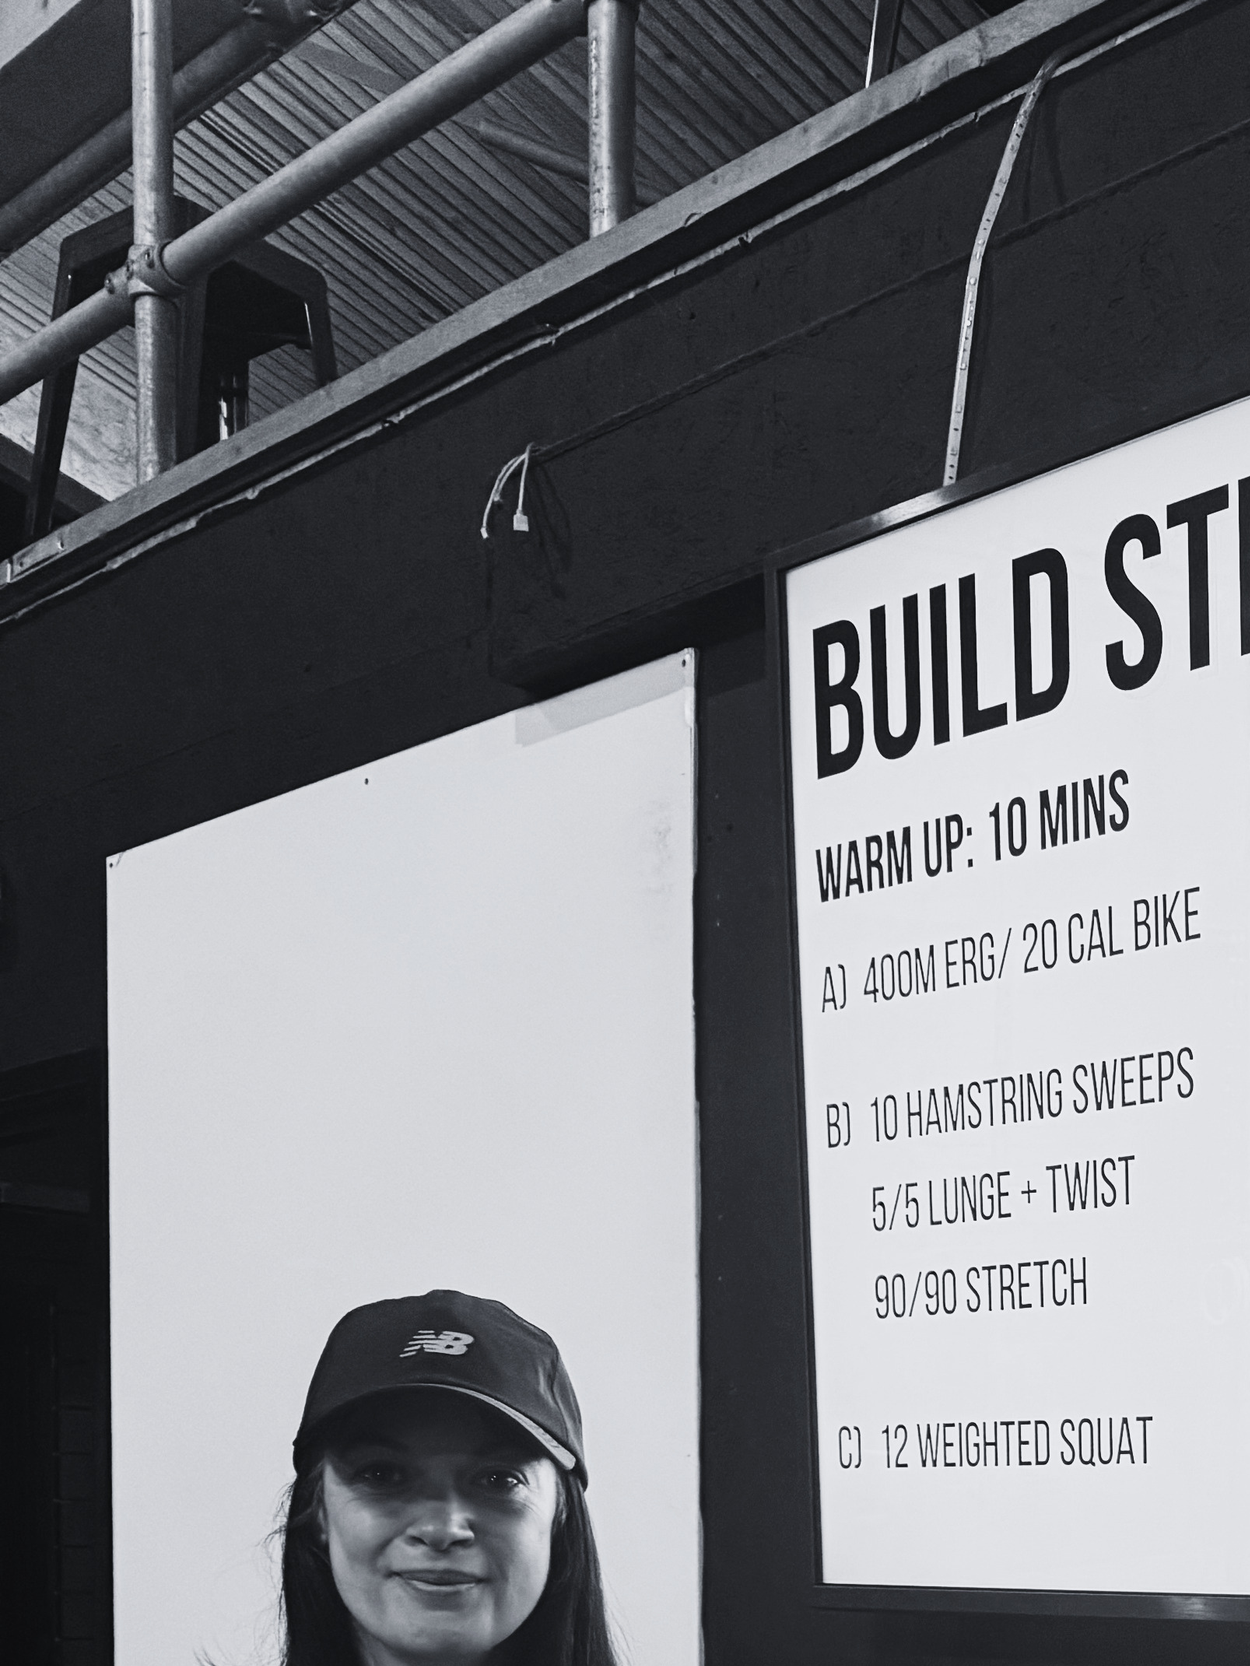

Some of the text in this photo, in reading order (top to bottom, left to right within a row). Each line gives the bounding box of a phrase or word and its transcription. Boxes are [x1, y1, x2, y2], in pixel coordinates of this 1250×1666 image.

[813, 548, 1070, 779] BUILD
[816, 769, 1129, 902] WARM UP: 10 MINS
[822, 887, 1201, 1012] A) 400M ERG/ 20 CAL BIKE
[827, 1047, 1193, 1148] B) 10 HAMSTRING SWEEPS
[873, 1155, 1135, 1232] 5/5 LUNGE + TWIST
[875, 1257, 1087, 1319] 90/90 STRETCH
[839, 1416, 1153, 1469] C) 12 WEIGHTED SQUAT
